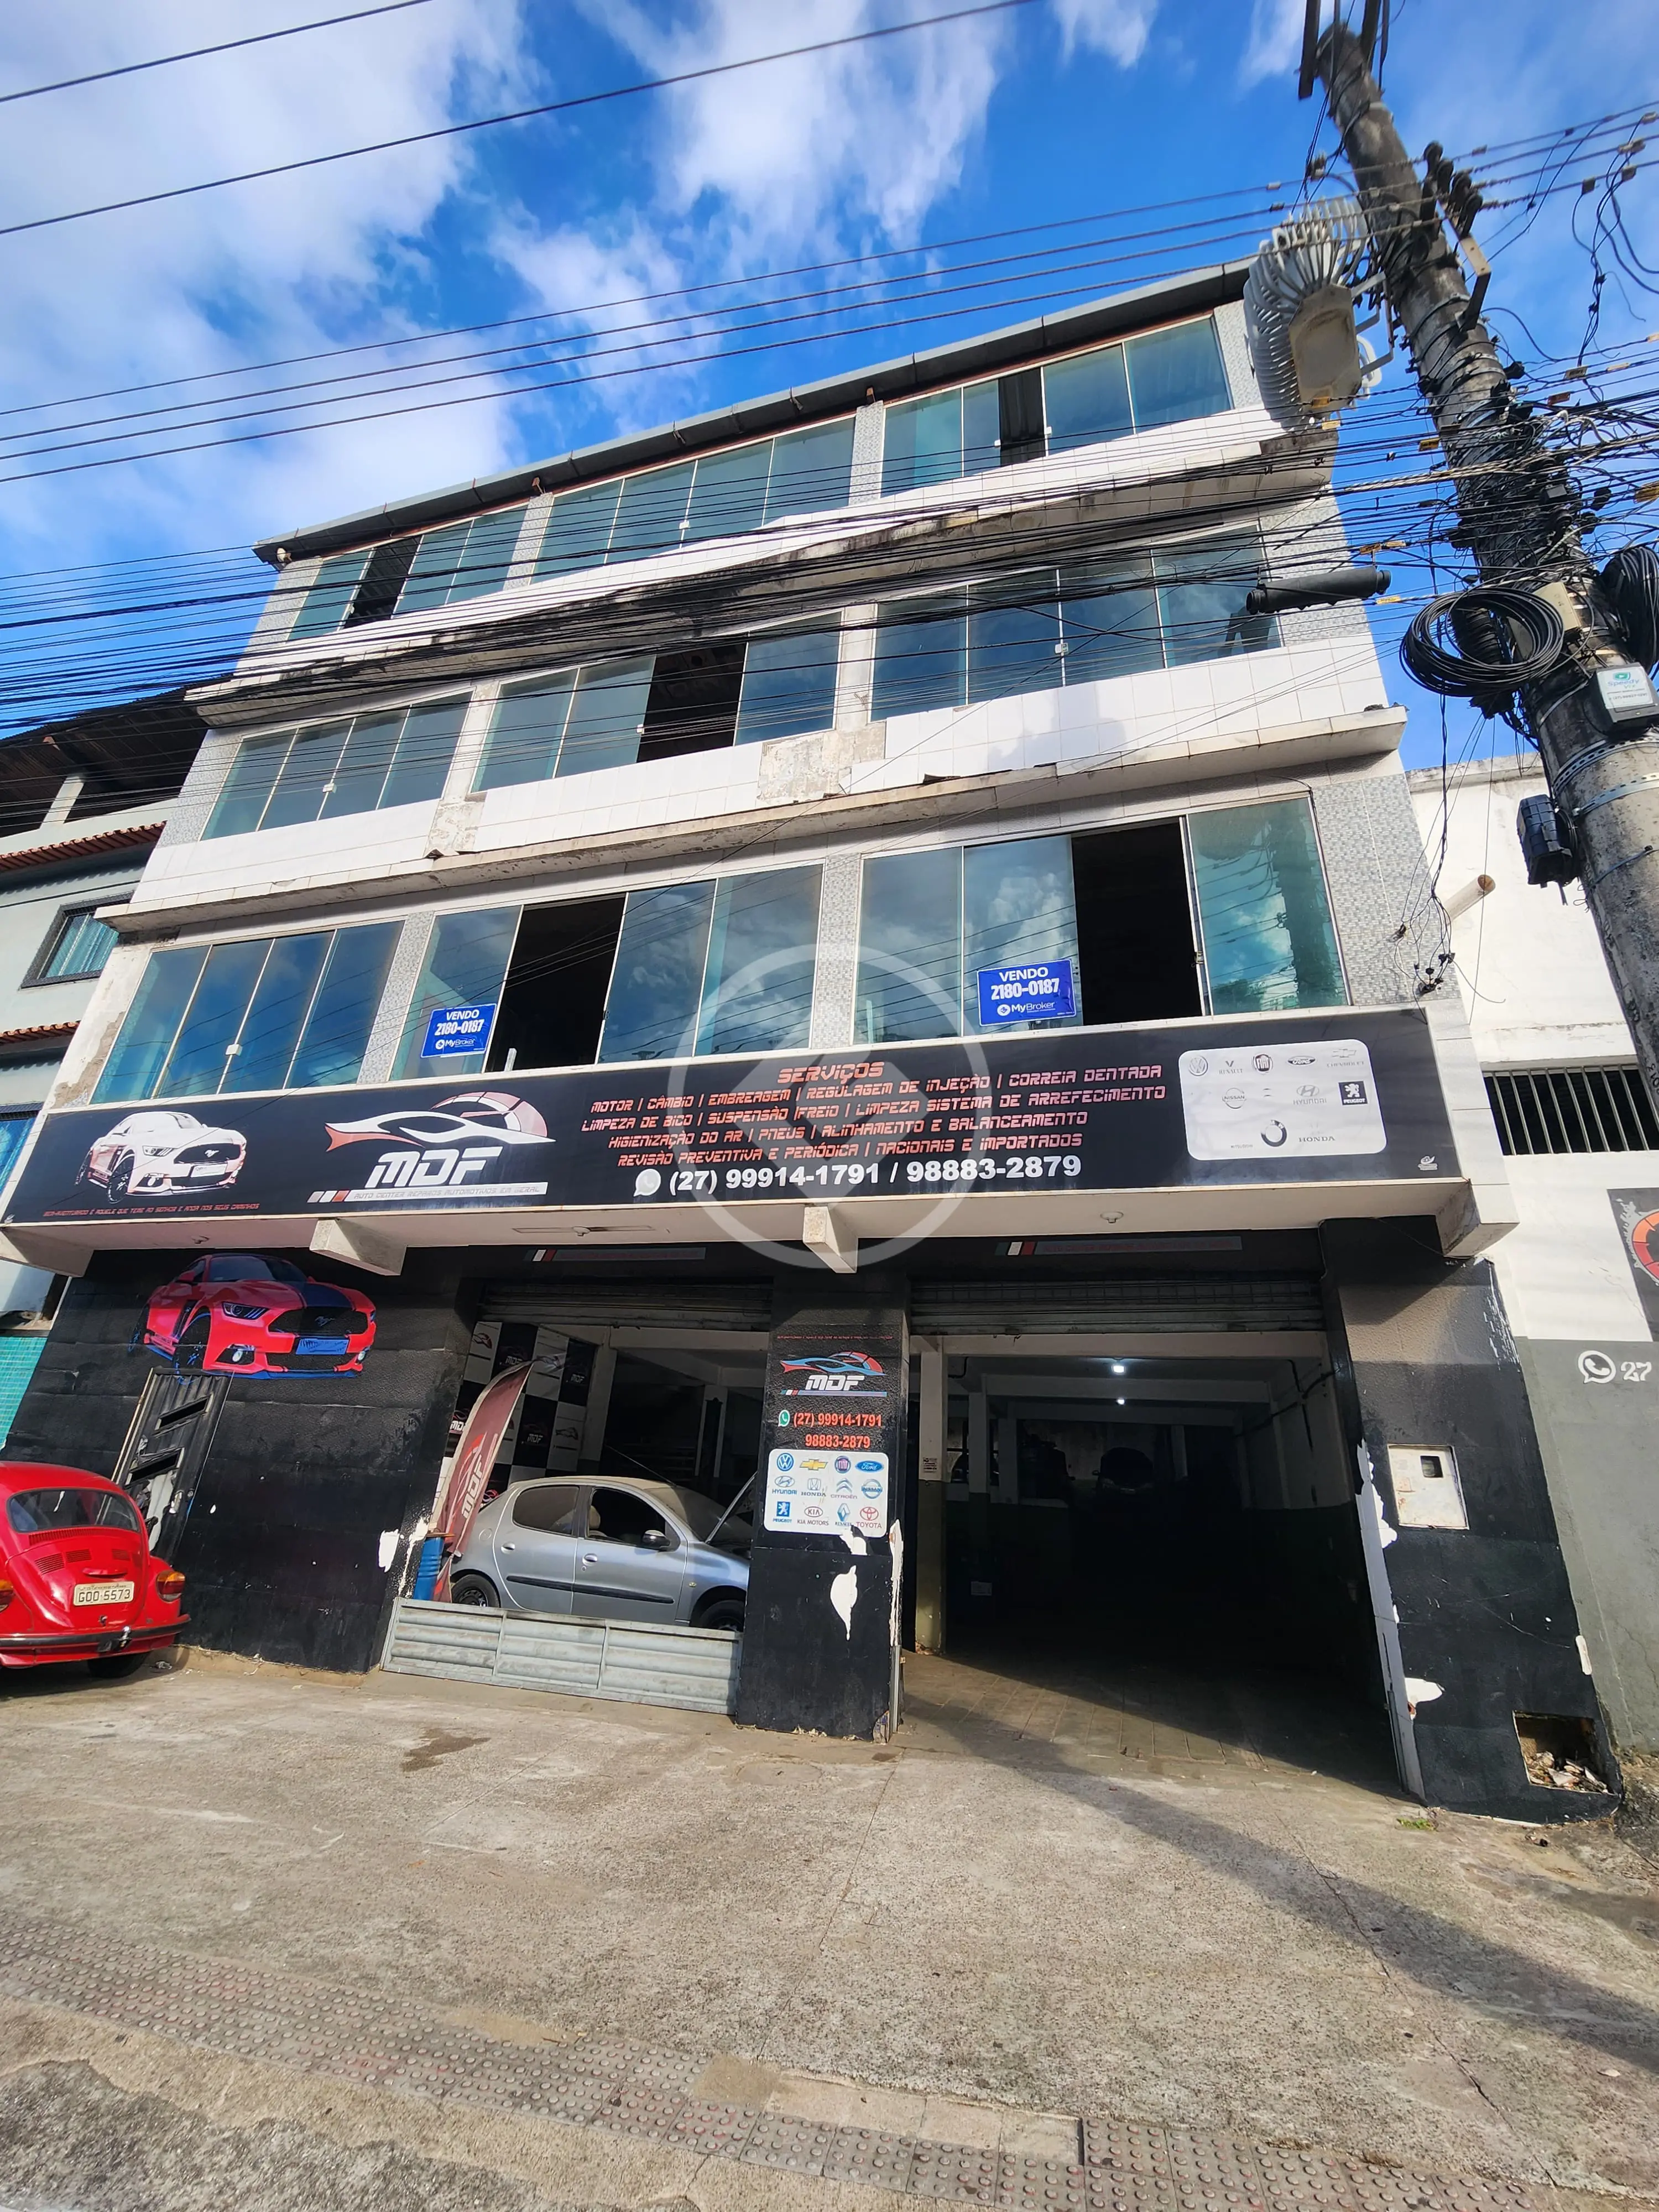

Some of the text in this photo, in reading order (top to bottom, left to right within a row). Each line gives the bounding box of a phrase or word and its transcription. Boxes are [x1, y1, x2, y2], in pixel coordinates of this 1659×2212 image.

[999, 967, 1048, 982] VENDO
[991, 978, 1060, 1000] 2180-0187
[446, 1009, 480, 1021] VENDO
[1011, 1001, 1055, 1013] MyBroker
[434, 1019, 485, 1036] 2180-0187
[778, 1061, 885, 1084] SERVIÇOS
[590, 1099, 634, 1113] MOTOR
[647, 1095, 695, 1110] CÂMBIO
[708, 1089, 791, 1106] EMBREAGEM
[806, 1082, 893, 1099] REGULAGEM
[899, 1081, 920, 1094] DE
[1009, 1070, 1077, 1087] CORREIA
[1084, 1065, 1162, 1082] DENTADA
[581, 1117, 636, 1132] LIMPEZA
[640, 1115, 659, 1129] DE
[663, 1114, 693, 1128] BICO
[855, 1100, 920, 1116] LIMPEZA
[926, 1095, 993, 1113] SISTEMA
[999, 1094, 1022, 1108] DE
[1028, 1086, 1166, 1107] ARREFECIMENTO
[699, 1131, 718, 1144] DO
[723, 1130, 743, 1143] AR
[758, 1126, 806, 1141] PNEUS
[821, 1119, 925, 1138] ALINHAMENTO
[931, 1119, 943, 1132] E
[948, 1112, 1088, 1131] BALANCEAMENTO
[677, 1148, 764, 1165] PREVENTIVA
[768, 1147, 780, 1160] E
[784, 1141, 859, 1160] PERIÓDICA
[875, 1139, 956, 1156] NACIONAIS
[961, 1138, 974, 1151] E
[979, 1133, 1083, 1151] IMPORTADOS
[364, 1146, 503, 1188] MDF
[669, 1170, 717, 1195] (27)
[726, 1162, 879, 1189] 99914-1791
[906, 1155, 1082, 1182] 98883-2879
[1620, 1361, 1652, 1381] 27
[805, 1374, 865, 1391] MDF
[450, 1420, 466, 1431] MD
[794, 1412, 882, 1428] (27) 99914-1791
[805, 1433, 871, 1449] 98883-2879
[862, 1462, 878, 1470] Ford
[461, 1454, 483, 1520] MDF
